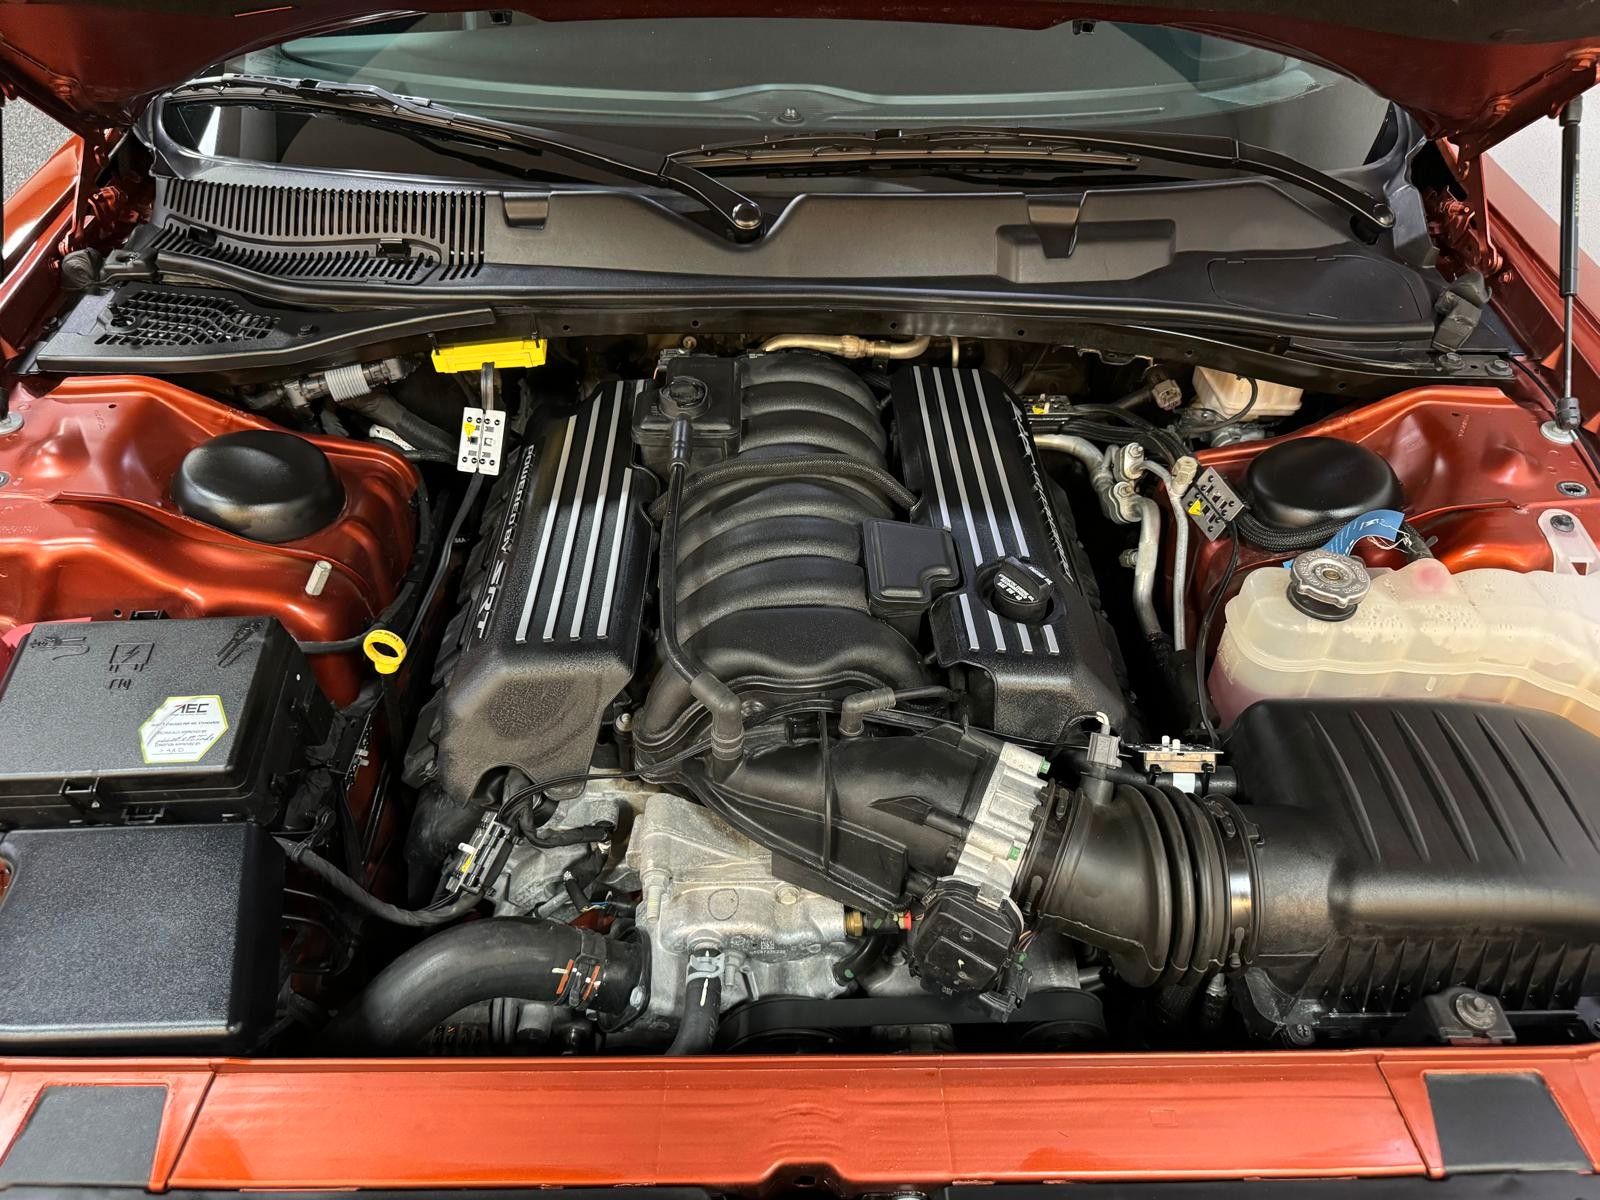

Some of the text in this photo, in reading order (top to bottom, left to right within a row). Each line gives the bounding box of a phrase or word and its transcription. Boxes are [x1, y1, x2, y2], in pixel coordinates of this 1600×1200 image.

[477, 444, 534, 639] POWERED BY SRT
[173, 703, 209, 713] AEC
